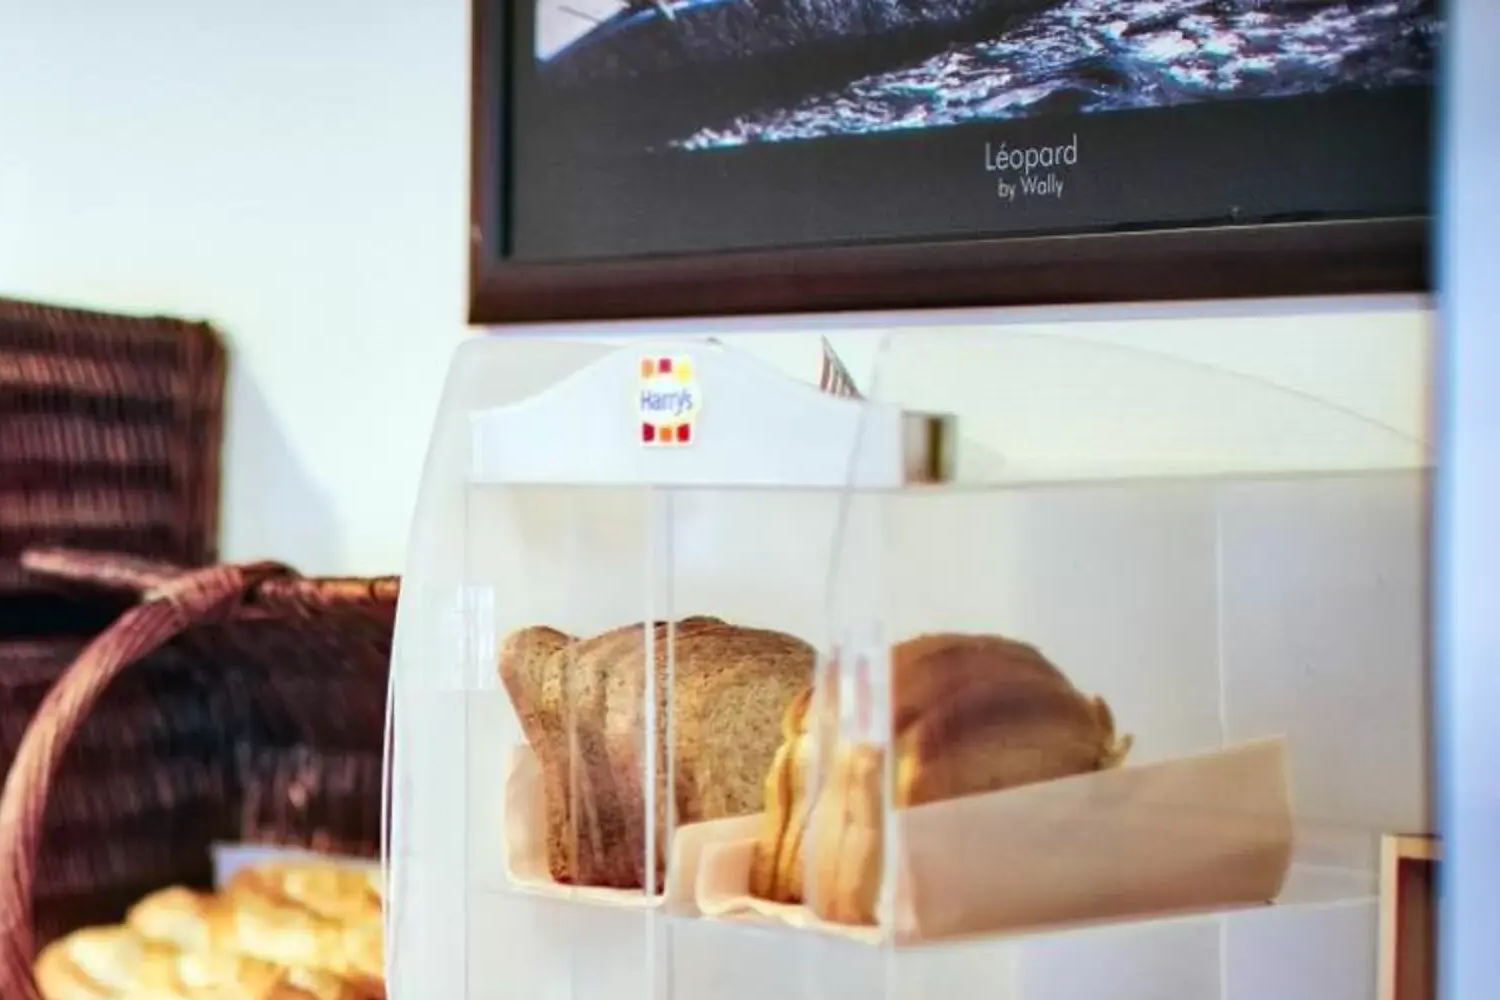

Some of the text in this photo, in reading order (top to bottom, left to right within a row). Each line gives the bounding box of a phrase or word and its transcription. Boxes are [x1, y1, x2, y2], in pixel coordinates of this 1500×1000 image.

[984, 133, 1078, 175] Léopard
[997, 172, 1064, 202] by Wally
